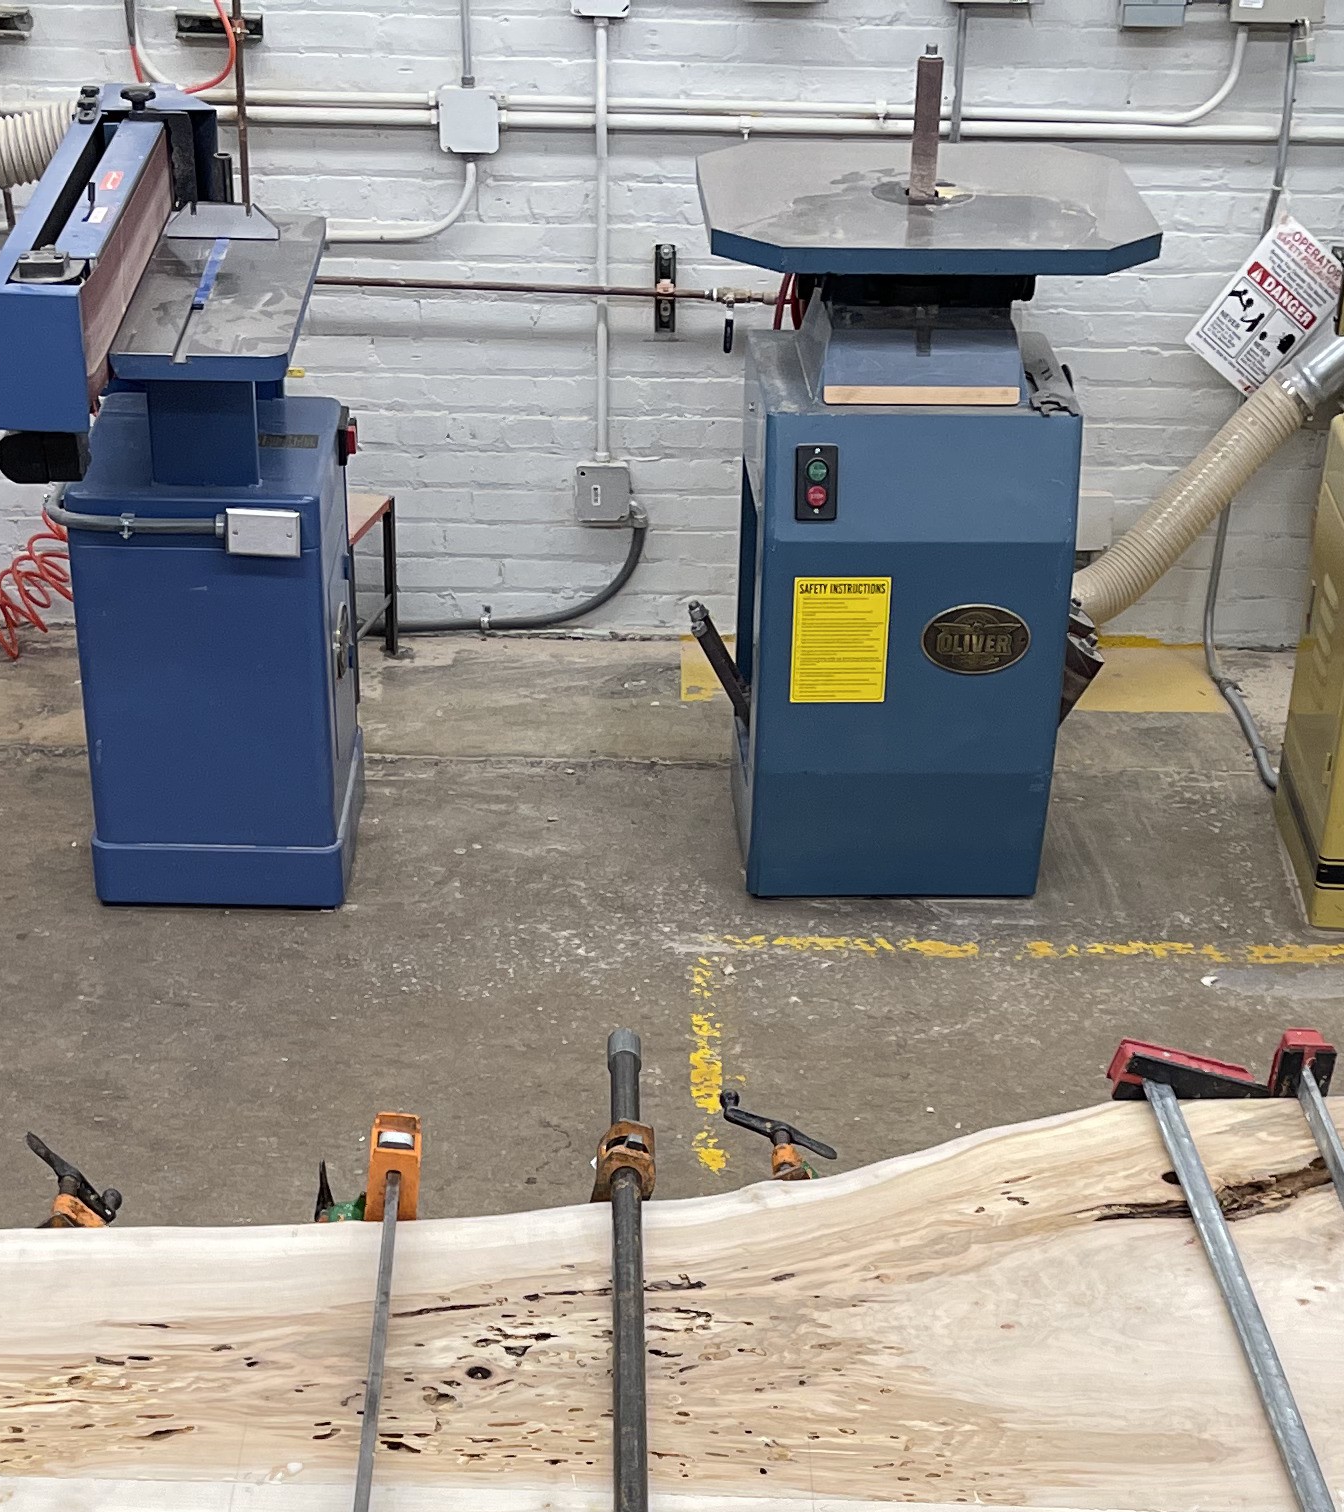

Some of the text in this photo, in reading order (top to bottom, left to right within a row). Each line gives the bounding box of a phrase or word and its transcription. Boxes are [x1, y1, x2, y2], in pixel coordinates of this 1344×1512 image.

[1292, 231, 1343, 280] OPERATOR
[1261, 275, 1313, 328] DANGER
[799, 583, 886, 595] SAFETY INSTRUCTIONS
[938, 633, 1009, 654] OLIVER
